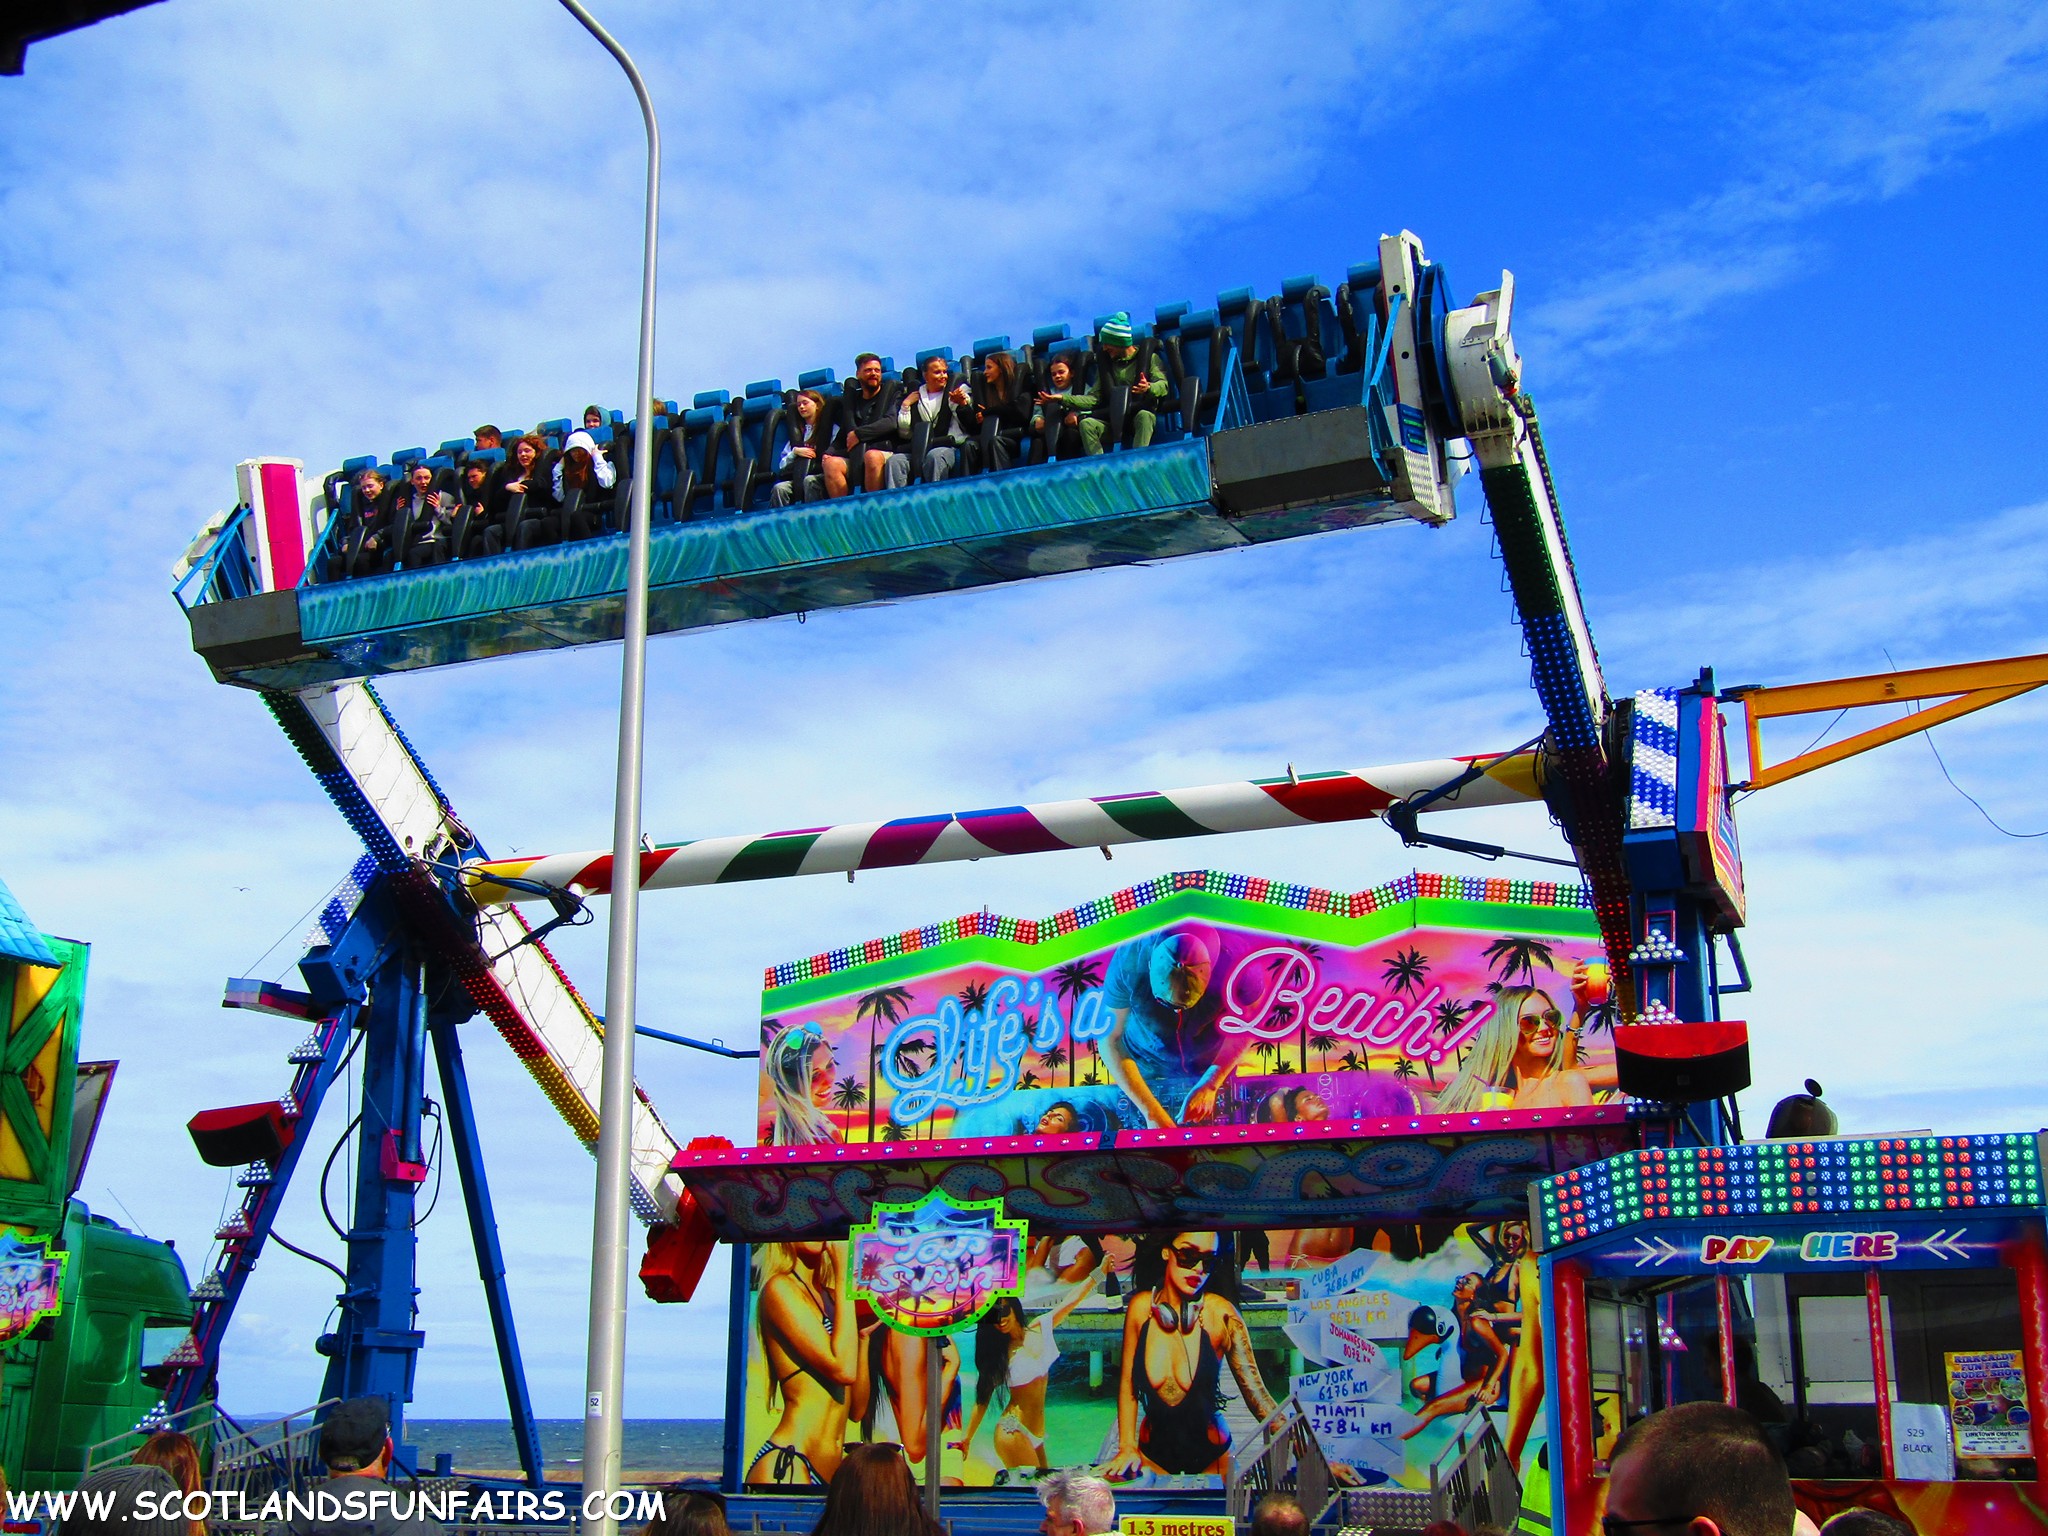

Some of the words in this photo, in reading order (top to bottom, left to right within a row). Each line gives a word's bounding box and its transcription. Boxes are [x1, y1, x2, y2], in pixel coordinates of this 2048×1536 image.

[883, 977, 1062, 1123] Life's
[1072, 987, 1114, 1040] a
[1218, 945, 1493, 1063] Beach!
[1702, 1235, 1773, 1264] PAY
[1801, 1231, 1898, 1261] HERE
[869, 1262, 993, 1293] Spin
[1311, 1264, 1339, 1287] CUBA
[1310, 1298, 1332, 1311] LOS
[1337, 1292, 1391, 1310] ANGELES
[1366, 1310, 1387, 1323] KM
[1952, 1371, 1988, 1379] MODEL
[1990, 1369, 2023, 1377] SHOW
[1962, 1363, 1982, 1371] FUN
[1985, 1361, 2010, 1369] FAIR
[1298, 1373, 1321, 1388] NEW
[1324, 1368, 1354, 1385] YORK
[1319, 1383, 1349, 1400] 6176
[1353, 1380, 1368, 1395] KM
[590, 1397, 599, 1407] 52
[1312, 1418, 1361, 1434] 7584
[1371, 1422, 1392, 1435] KM
[1906, 1428, 1925, 1438] S29
[1903, 1443, 1934, 1453] BLACK
[1128, 1520, 1155, 1536] 1.3
[1161, 1521, 1225, 1536] metres
